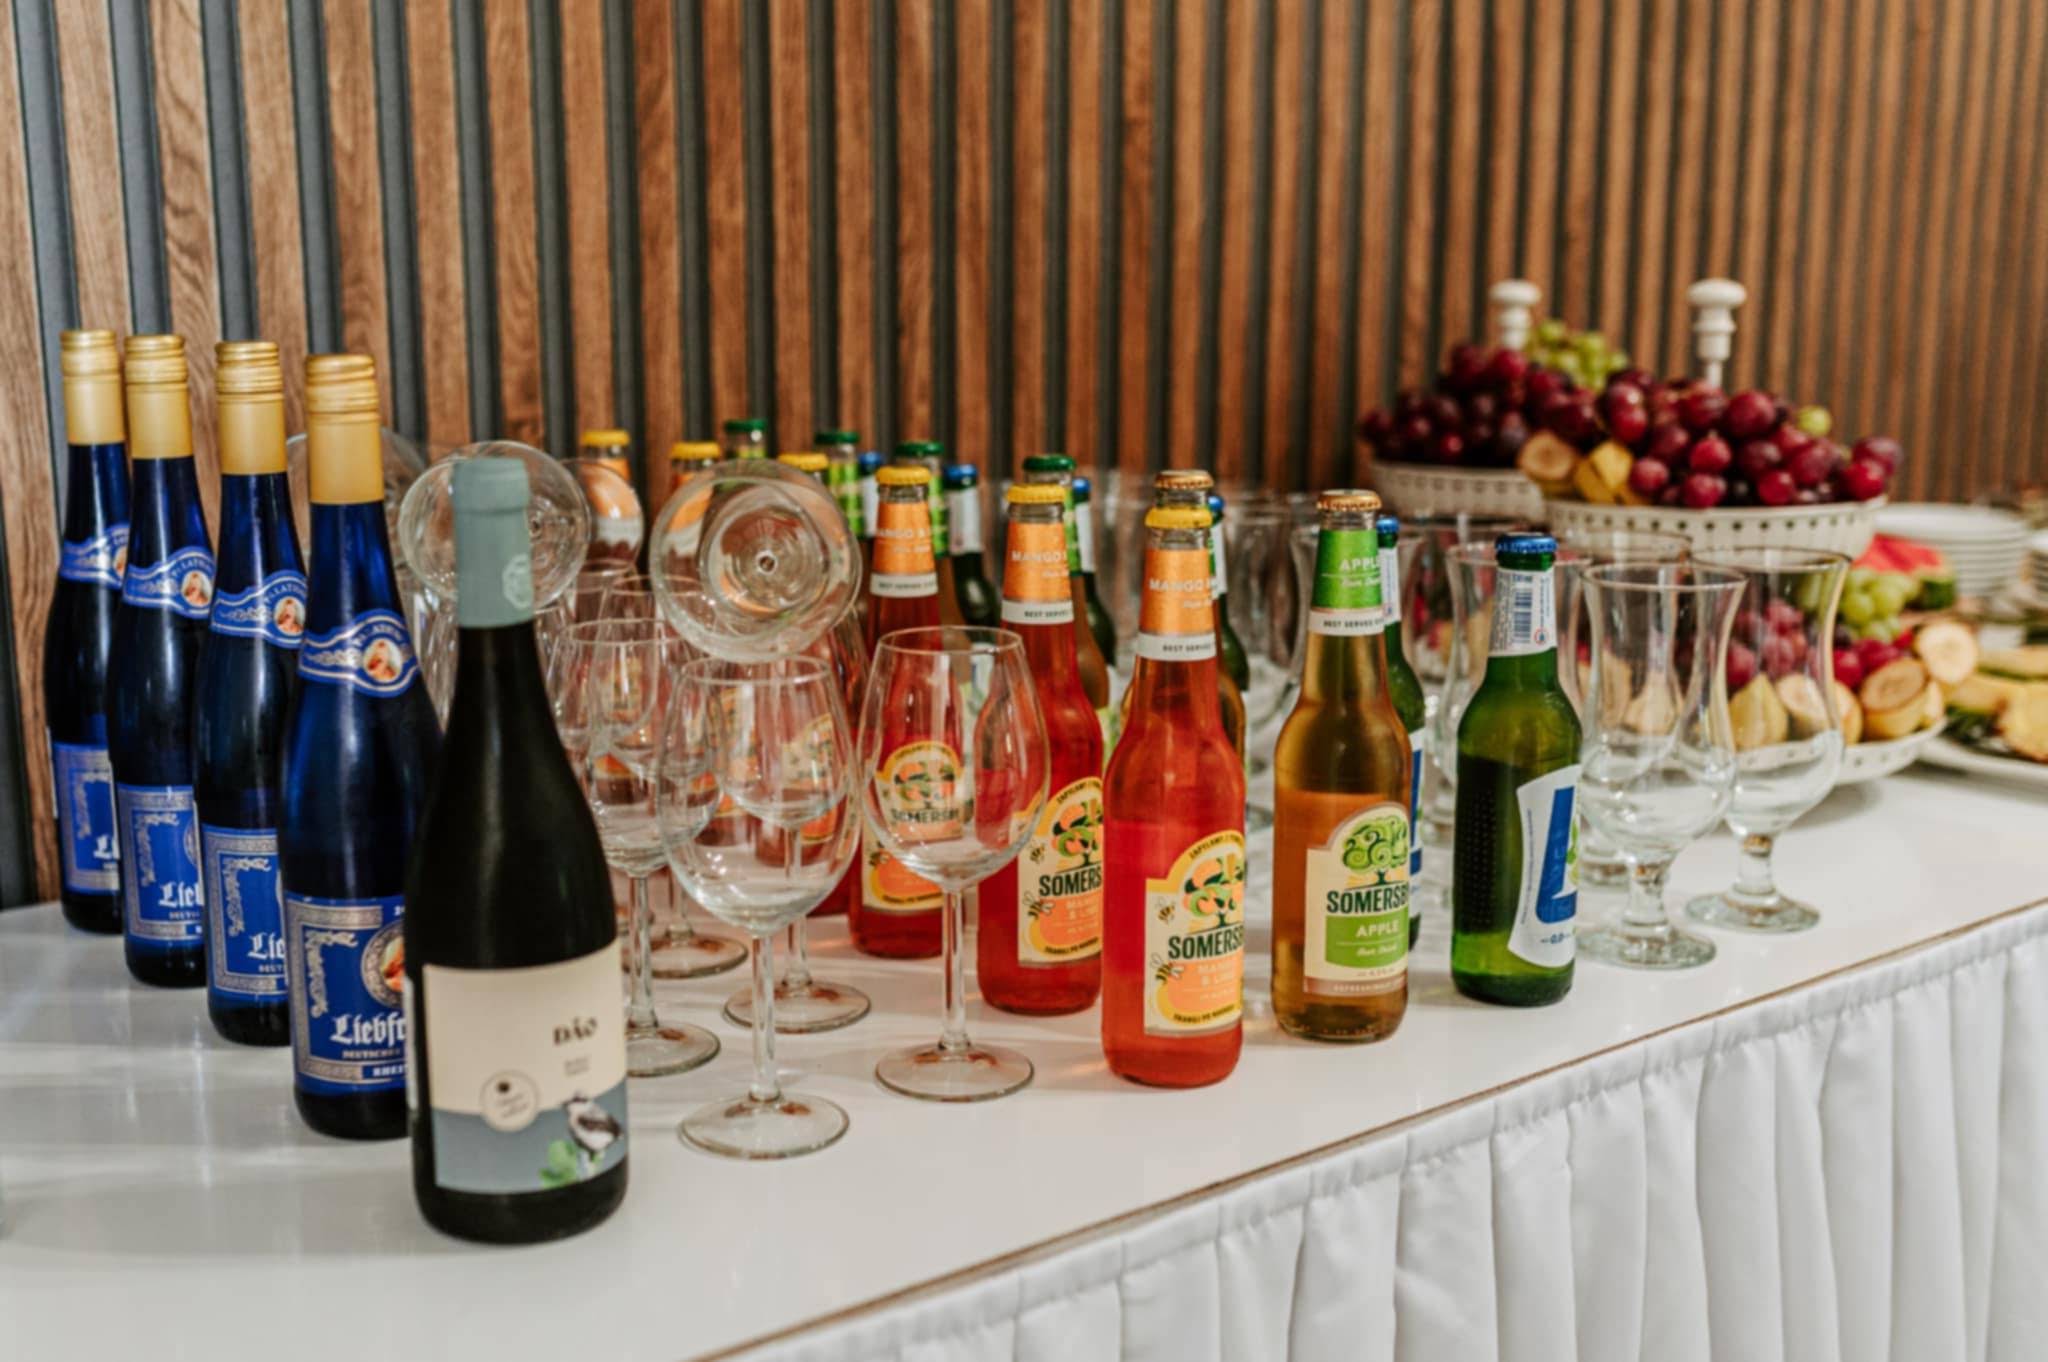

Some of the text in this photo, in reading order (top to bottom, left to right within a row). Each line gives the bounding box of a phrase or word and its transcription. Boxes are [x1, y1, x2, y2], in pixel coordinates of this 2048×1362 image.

[1149, 578, 1204, 592] MANGO
[1327, 881, 1409, 914] SOMERSB
[1355, 919, 1399, 938] APPLE
